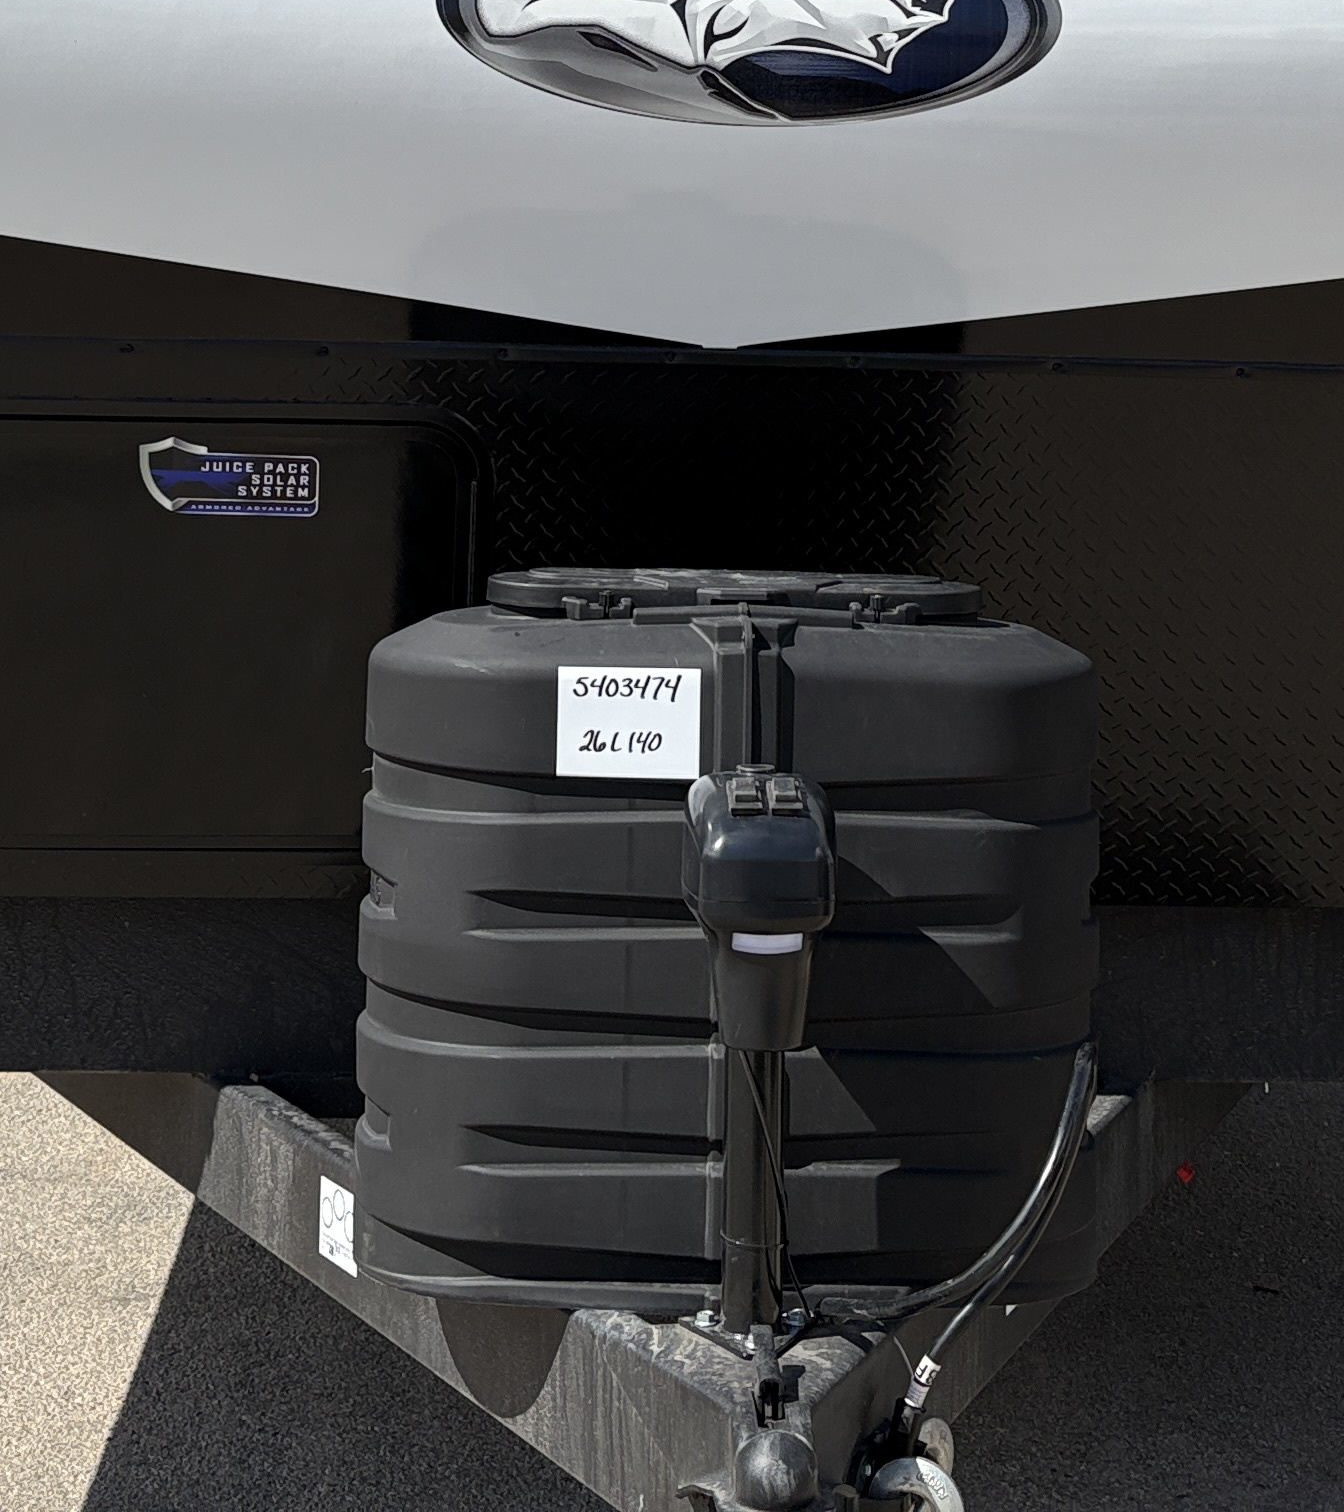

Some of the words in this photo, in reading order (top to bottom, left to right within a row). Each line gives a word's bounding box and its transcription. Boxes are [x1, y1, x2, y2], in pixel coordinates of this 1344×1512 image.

[200, 461, 255, 473] JUICE
[264, 462, 310, 474] PACK
[251, 474, 310, 486] SOLAR
[237, 485, 310, 498] SYSTEM
[246, 505, 310, 513] ADVANTAGE
[572, 674, 683, 703] 5403474
